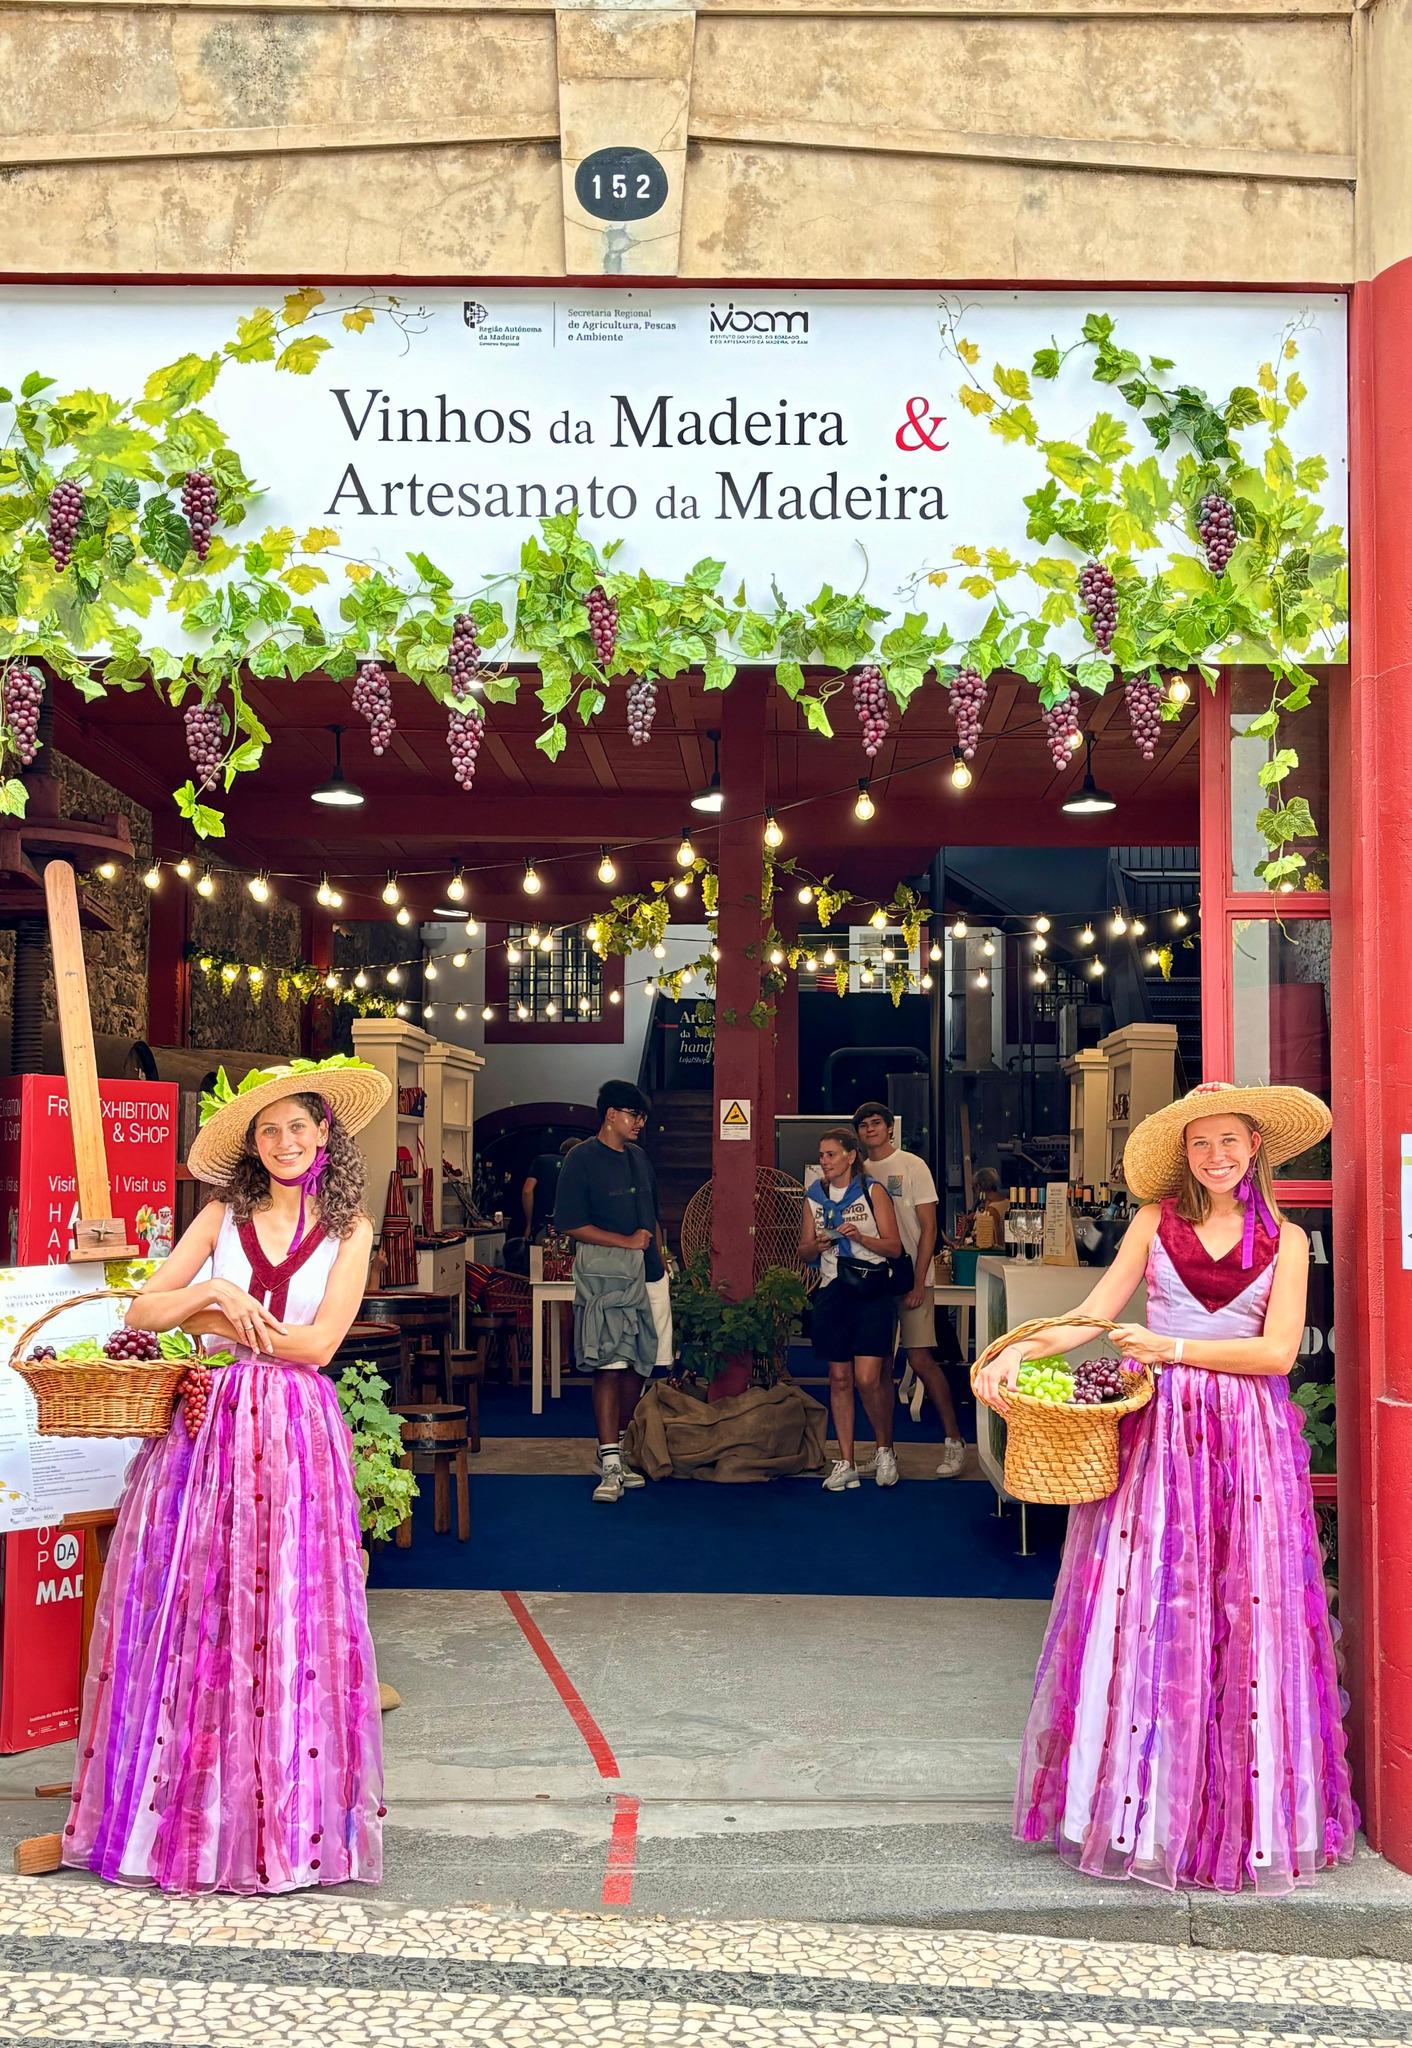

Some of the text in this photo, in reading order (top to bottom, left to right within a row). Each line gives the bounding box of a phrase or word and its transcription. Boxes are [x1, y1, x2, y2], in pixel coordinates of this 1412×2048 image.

[592, 173, 652, 200] 152
[567, 308, 652, 319] Secretaria Regional
[478, 325, 542, 334] Região Autónoma
[567, 320, 677, 331] de Agricultura, Pescas
[576, 332, 624, 341] Ambiente
[328, 388, 950, 452] Vinhos da Madeira &
[323, 463, 949, 521] Artesanato da Madeira
[48, 1095, 170, 1121] FR XHIBITION
[113, 1122, 125, 1143] &
[123, 1176, 149, 1192] Visit
[152, 1180, 167, 1192] us
[56, 1541, 77, 1562] DA
